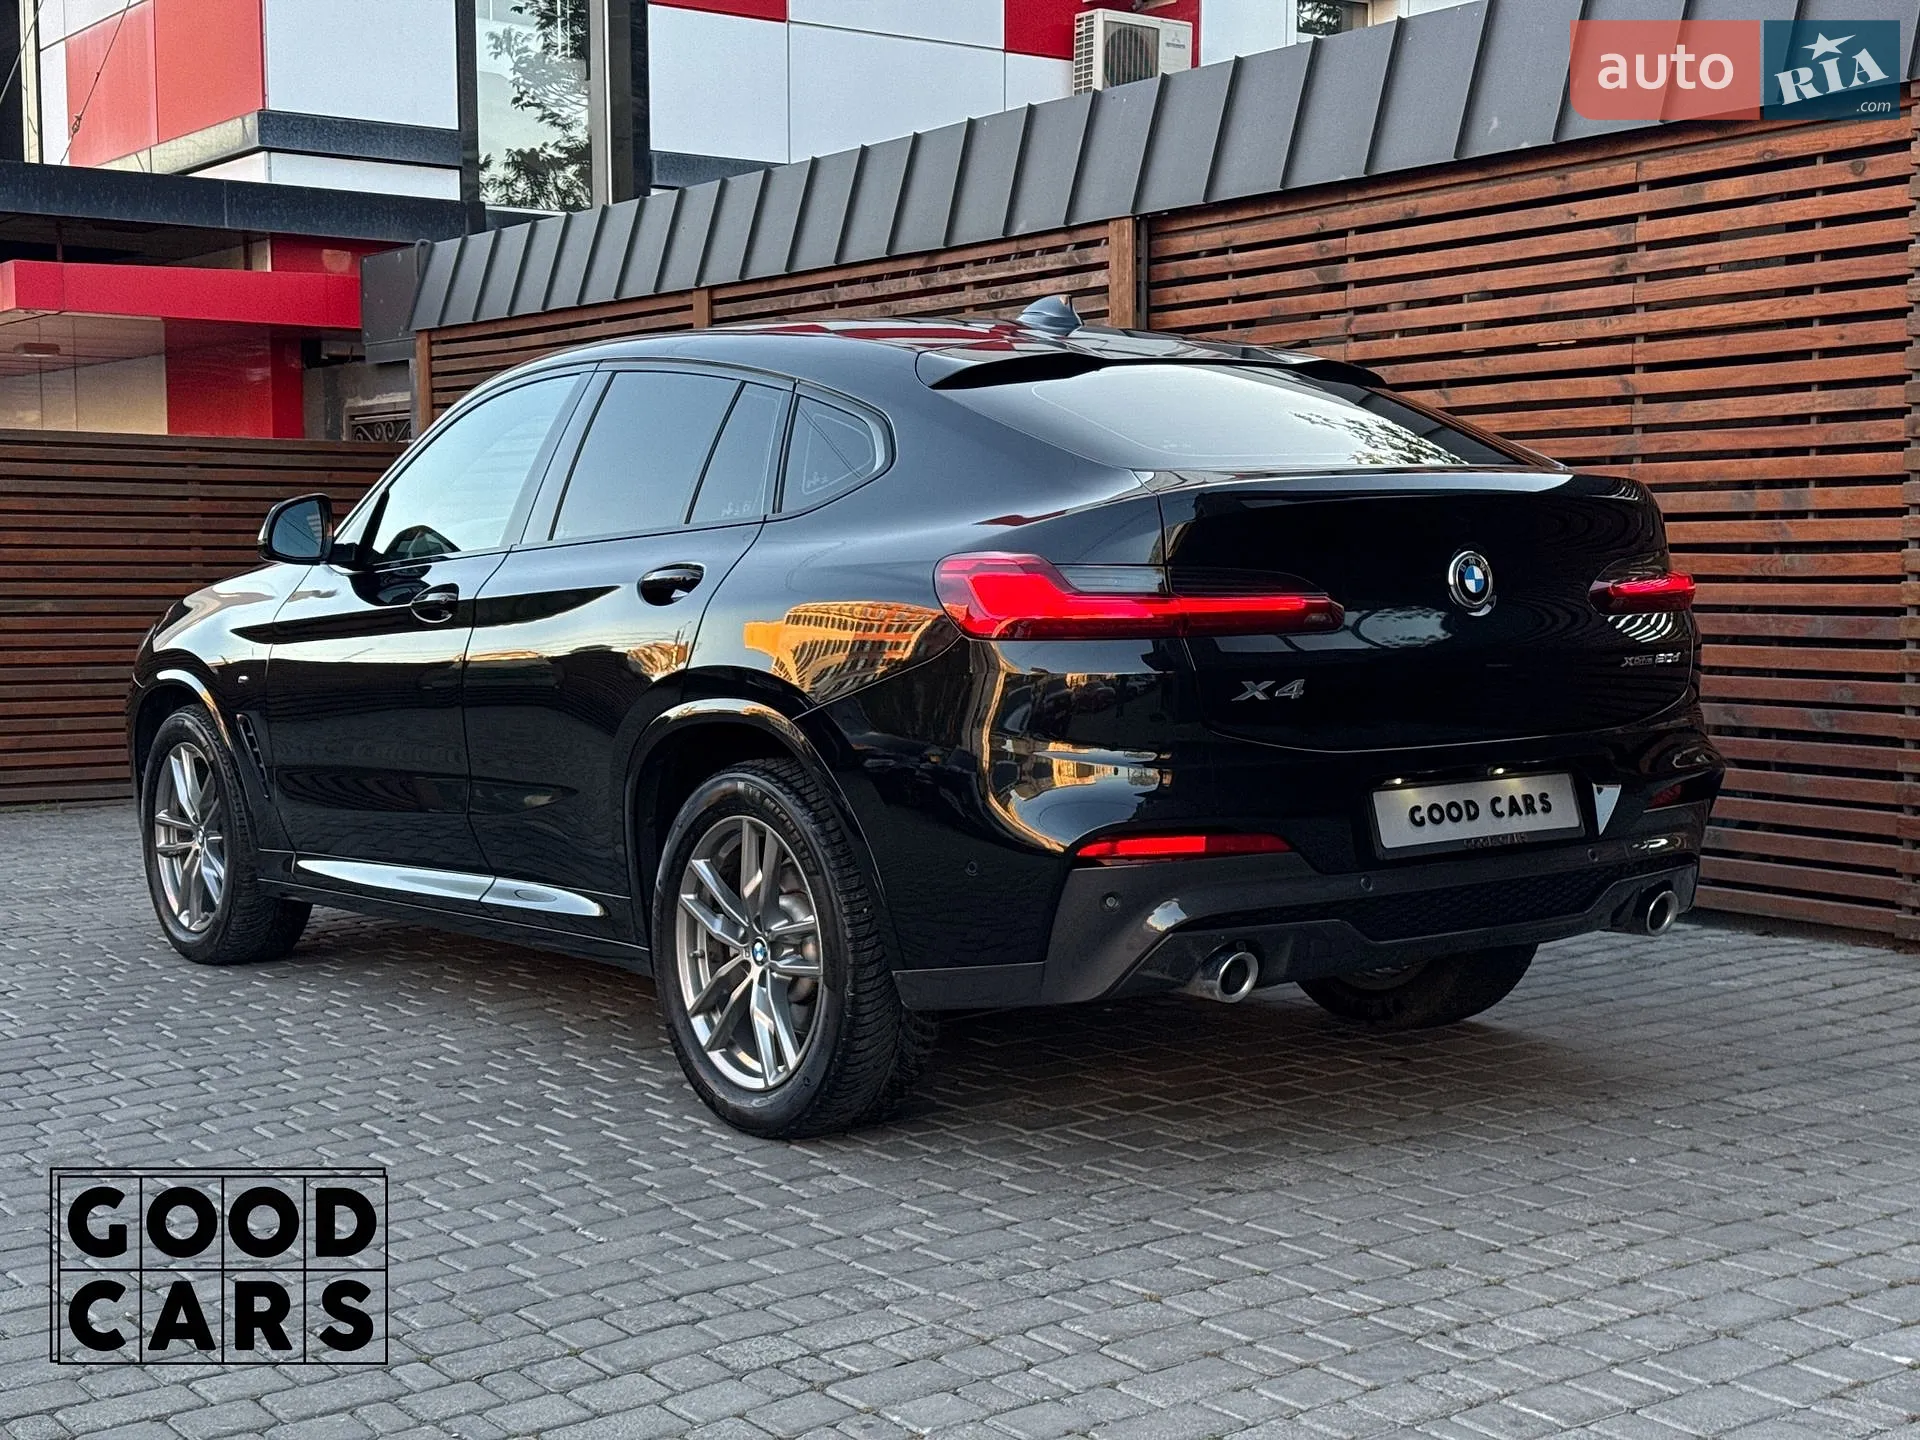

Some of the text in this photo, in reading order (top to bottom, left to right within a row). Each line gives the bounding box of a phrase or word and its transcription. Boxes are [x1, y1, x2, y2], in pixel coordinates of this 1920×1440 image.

[1460, 557, 1487, 573] BMW
[1231, 679, 1305, 701] X4
[1409, 792, 1553, 827] GOOD CARS
